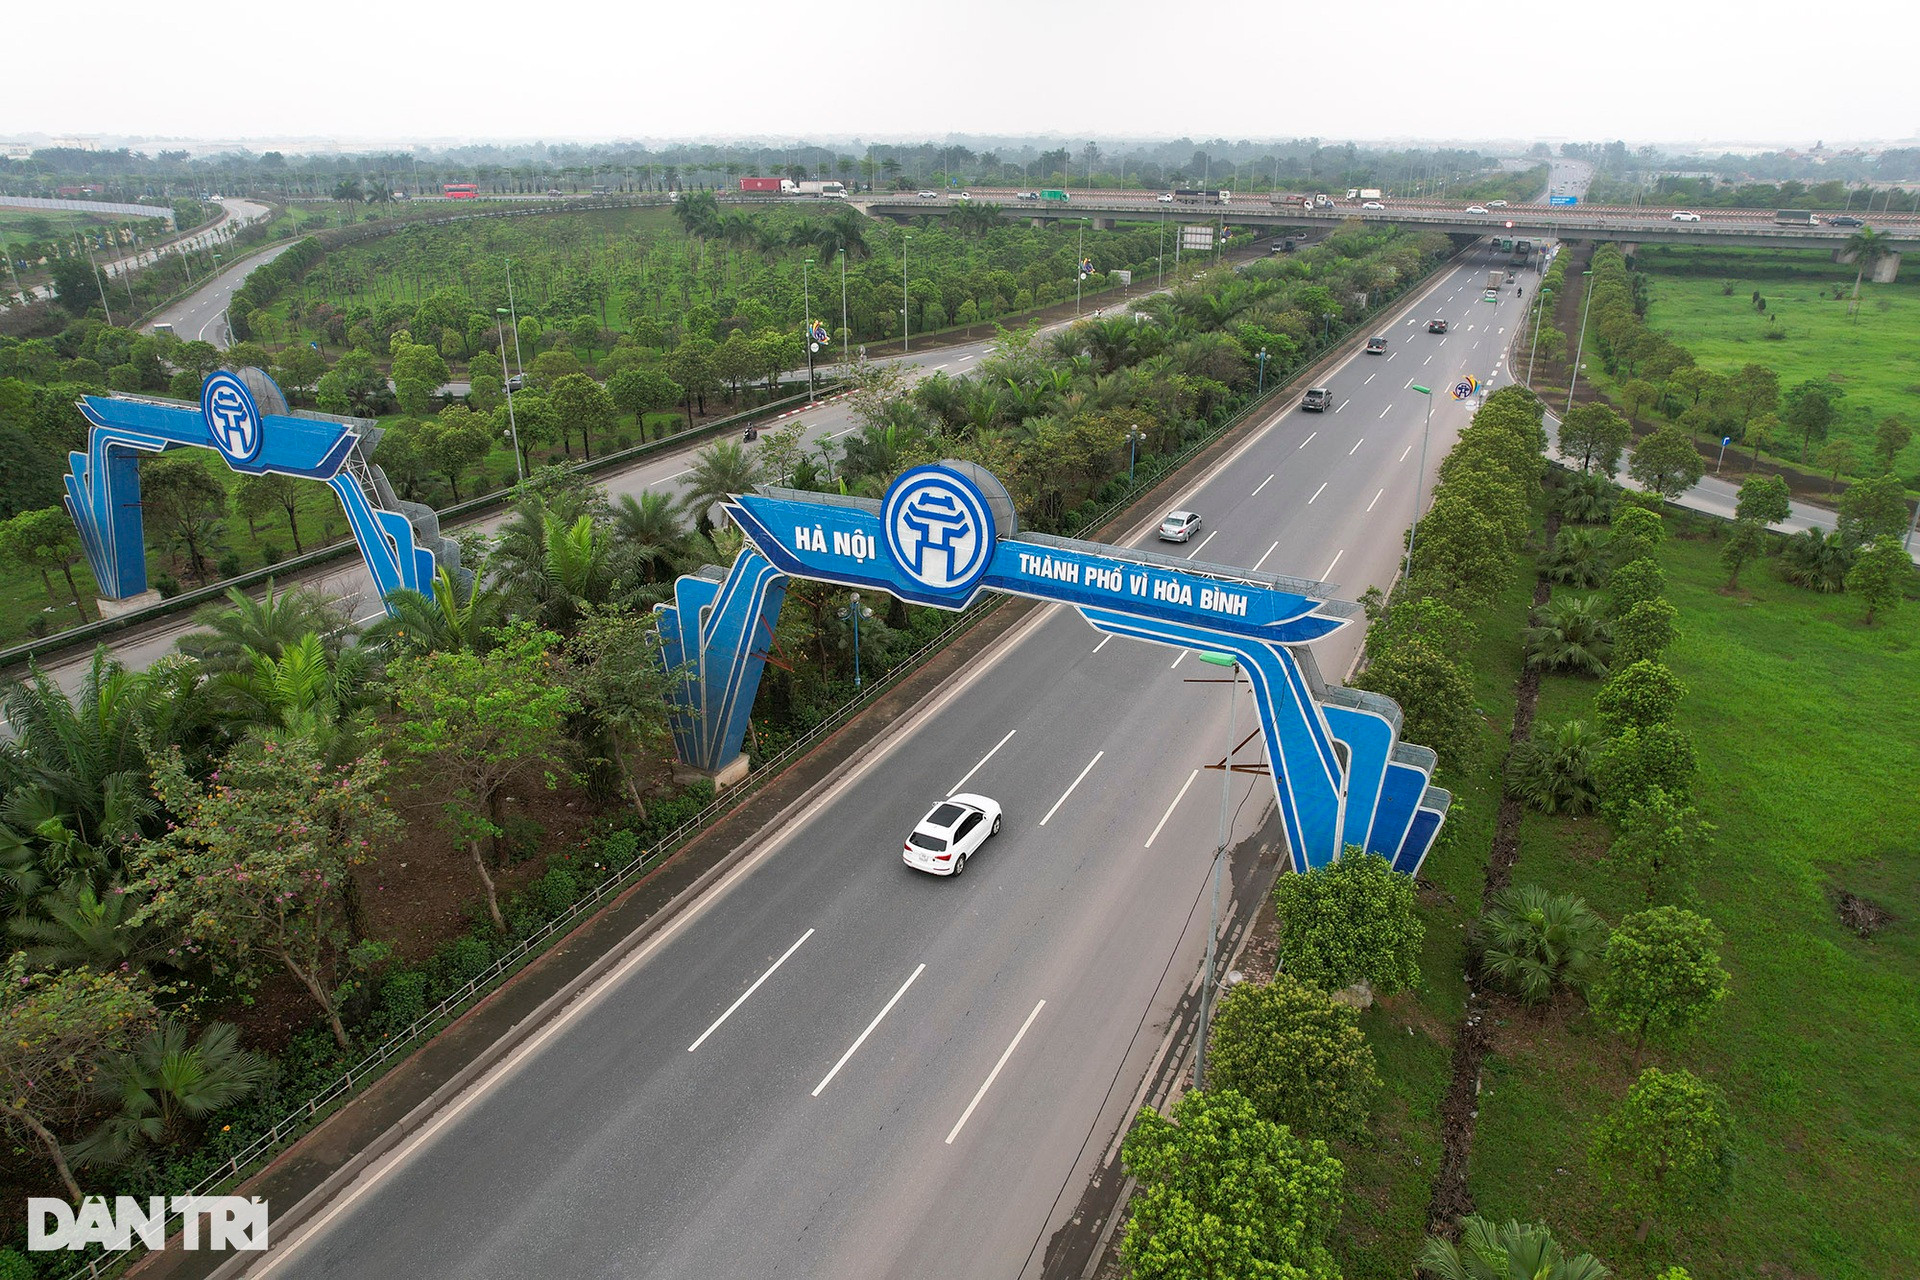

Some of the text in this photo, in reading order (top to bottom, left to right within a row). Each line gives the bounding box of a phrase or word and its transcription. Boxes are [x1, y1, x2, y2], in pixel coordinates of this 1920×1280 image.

[795, 524, 876, 564] HÀ NỘI
[1019, 553, 1248, 616] THÀNH PHỐ VÌ HÒA BÌNH
